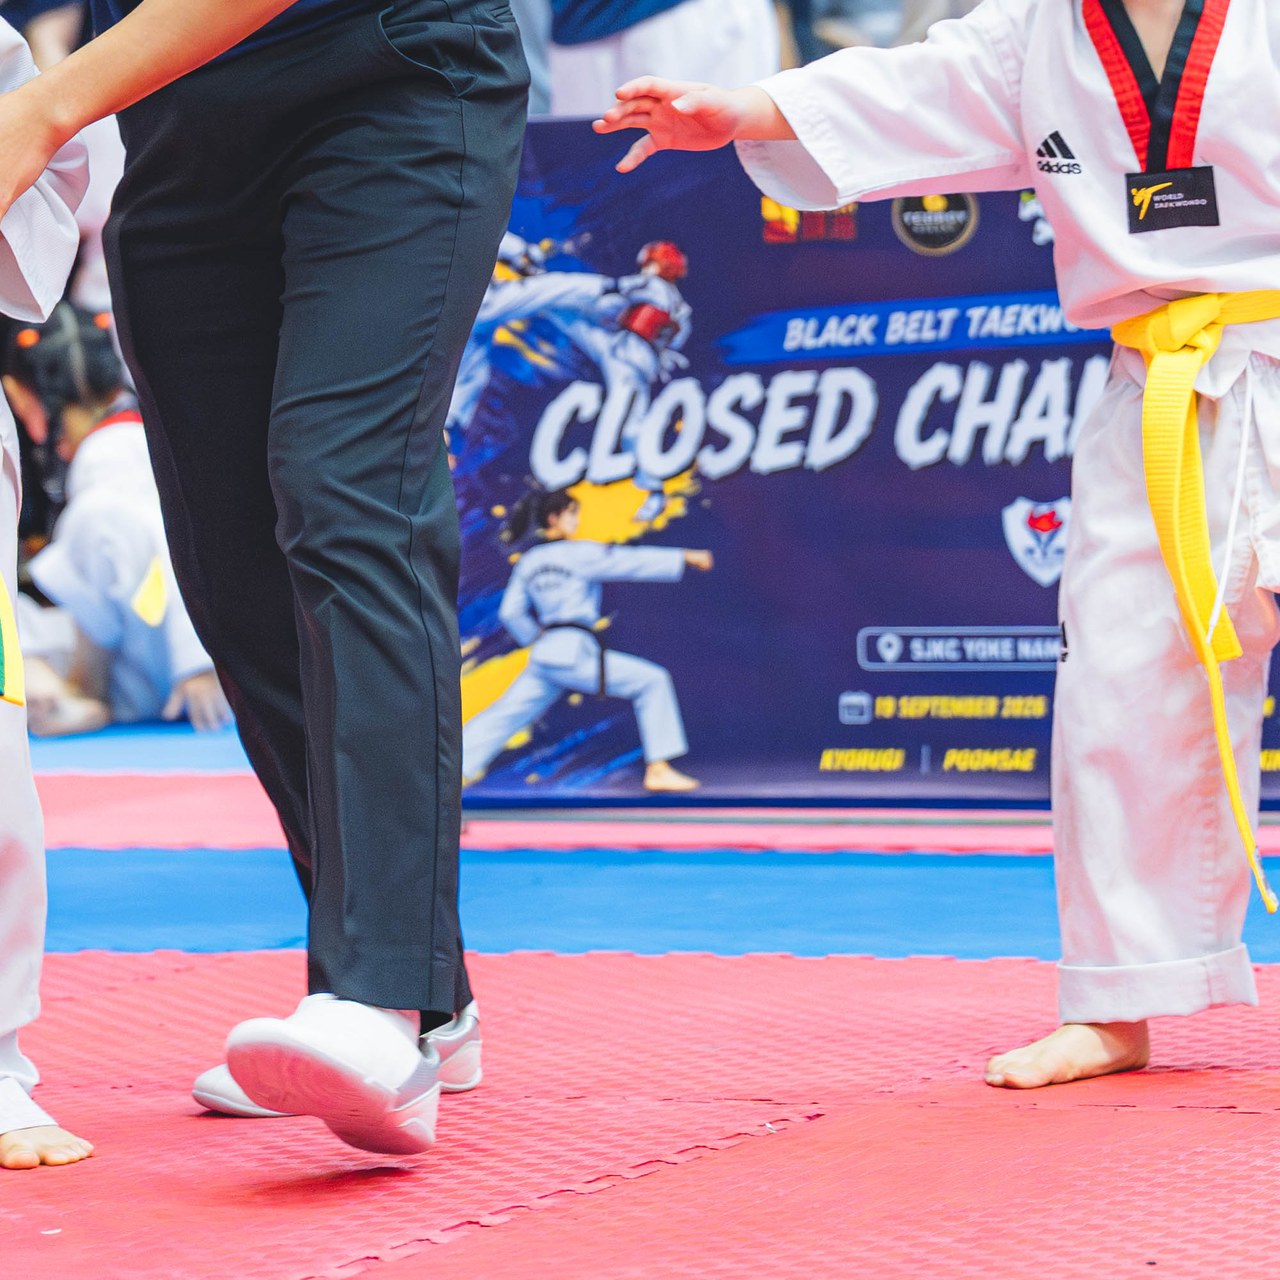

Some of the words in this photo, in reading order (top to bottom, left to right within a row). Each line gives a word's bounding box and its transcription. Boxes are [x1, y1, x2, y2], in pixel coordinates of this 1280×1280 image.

[1153, 193, 1183, 202] WORLD
[783, 314, 876, 351] BLACK
[884, 308, 958, 345] BELT
[965, 303, 1078, 338] TAEKW
[529, 366, 878, 492] CLOSED
[898, 695, 1000, 719] SEPTEMBER
[943, 748, 1037, 771] POOMSAE
